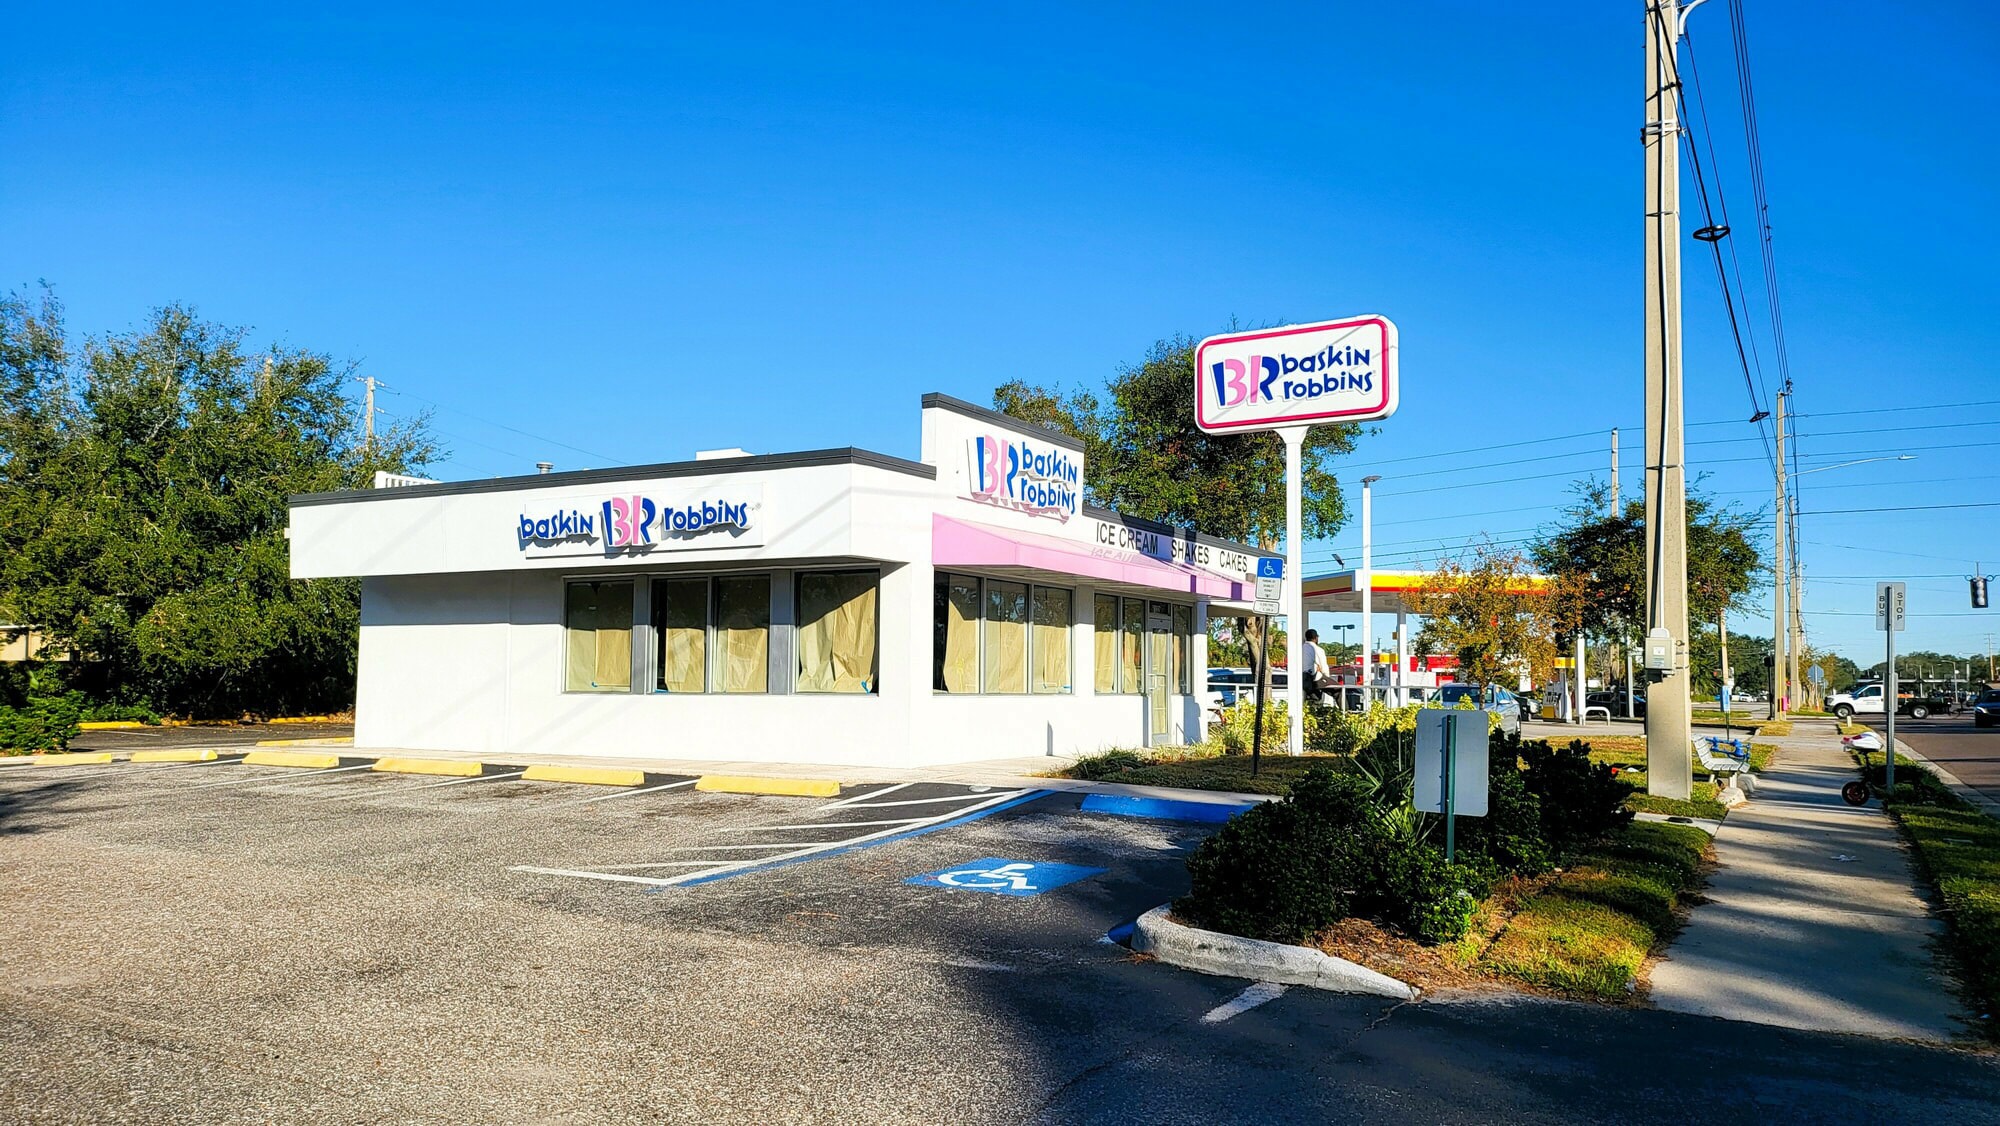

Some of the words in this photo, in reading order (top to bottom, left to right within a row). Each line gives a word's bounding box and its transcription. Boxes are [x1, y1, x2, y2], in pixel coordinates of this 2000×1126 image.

[1212, 355, 1280, 406] BR
[1280, 345, 1370, 375] baskin
[1283, 371, 1373, 400] robbins
[976, 434, 1019, 498] BR
[1022, 441, 1077, 487] baskin
[1021, 477, 1076, 514] robbins
[520, 509, 593, 539] baskin
[602, 495, 656, 547] BR
[664, 499, 748, 531] robbins
[1096, 521, 1115, 545] ICE
[1119, 527, 1158, 555] CREAM
[1171, 539, 1210, 565] SHAKES
[1219, 550, 1248, 573] CAKES
